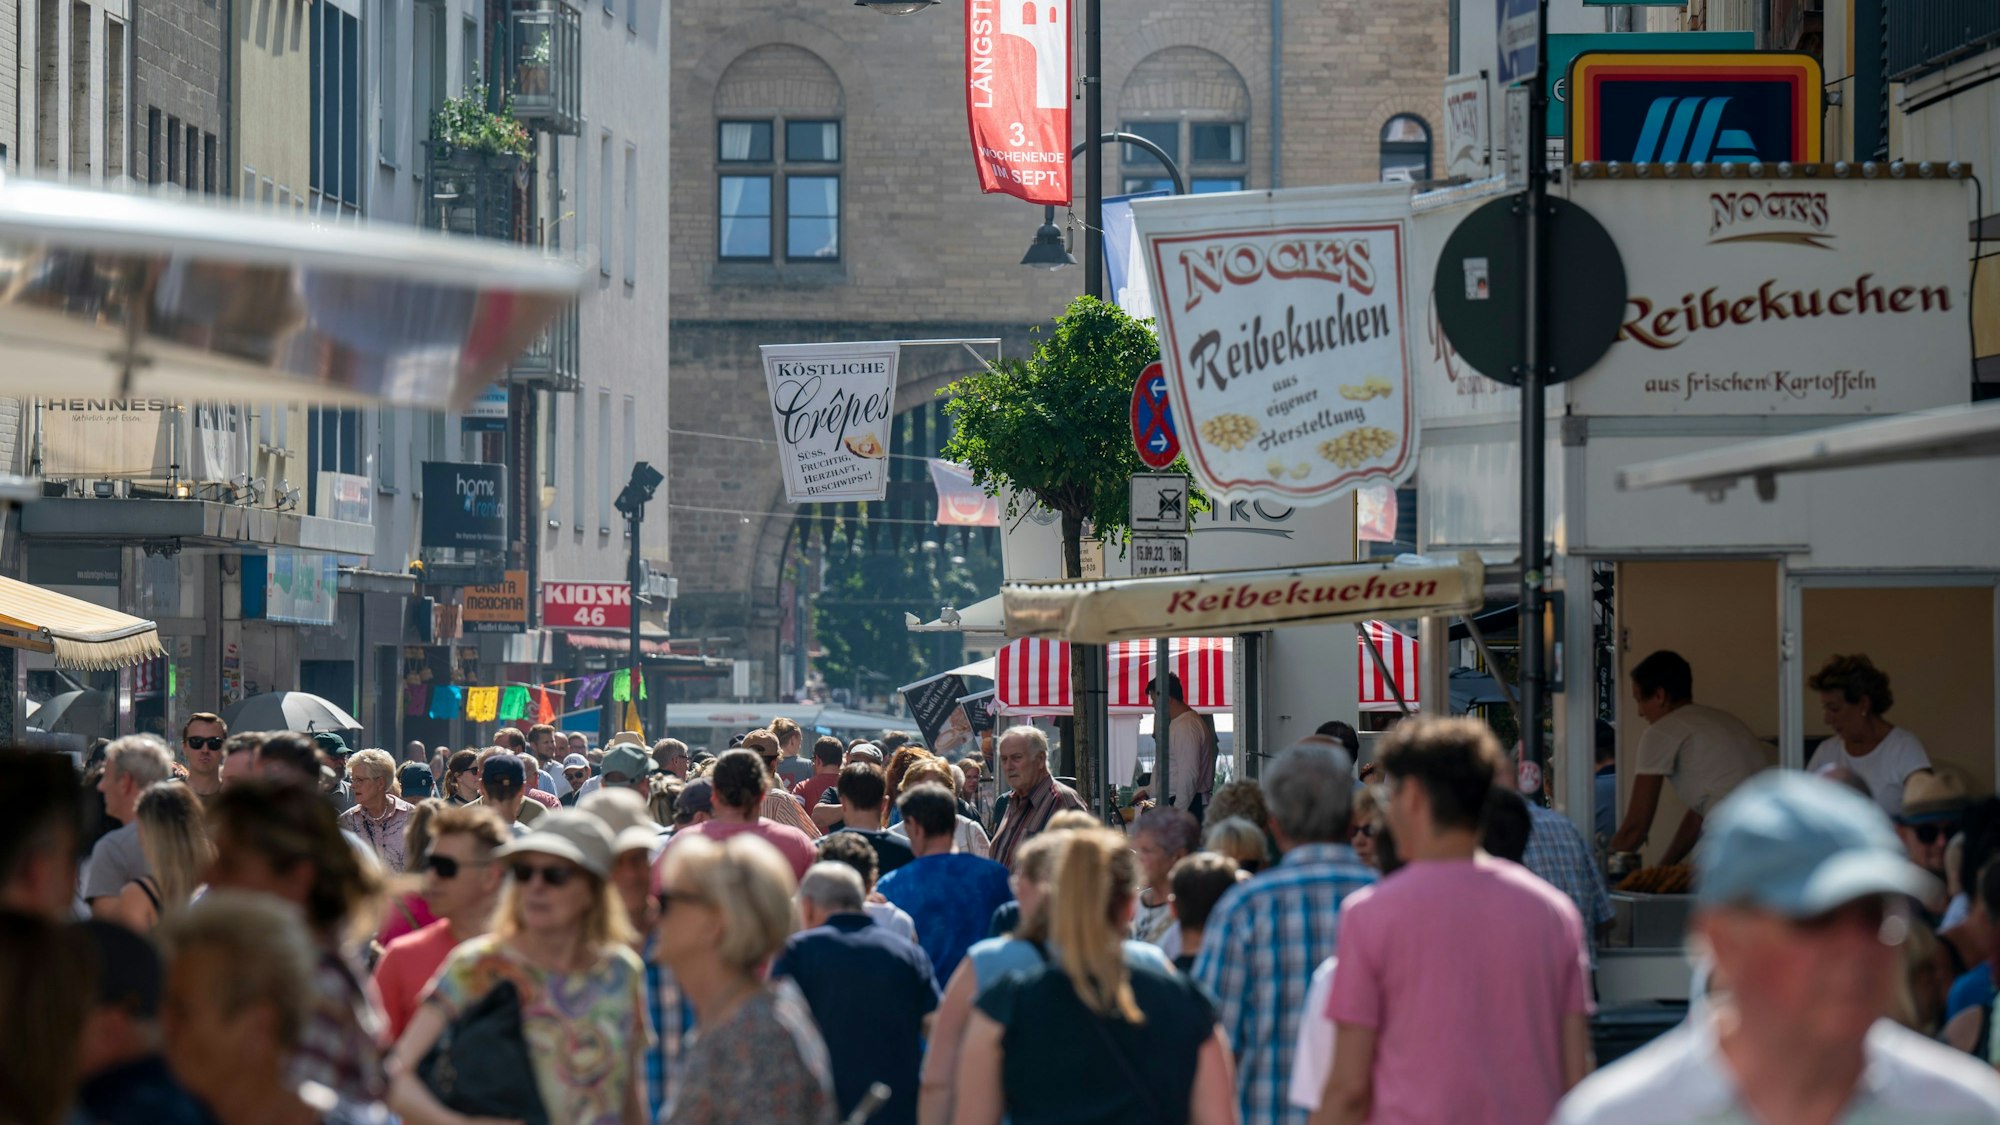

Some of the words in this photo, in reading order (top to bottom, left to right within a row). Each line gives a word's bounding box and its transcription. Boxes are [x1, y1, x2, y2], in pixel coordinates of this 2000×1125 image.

[970, 0, 993, 108] LÄNGST
[1009, 122, 1034, 147] 3.
[979, 147, 1065, 164] WOCHENENDE
[992, 163, 1009, 179] IM
[1011, 170, 1061, 187] SEPT.
[1709, 192, 1830, 235] NOCK'S
[1179, 239, 1376, 313] NOCK'S
[1614, 273, 1953, 350] Reibekuchen
[1188, 293, 1391, 392] Reibekuchen
[777, 362, 886, 377] KÖSTLICHE
[1272, 375, 1298, 393] aus
[1645, 379, 1680, 393] aus
[1685, 371, 1767, 401] frischen
[1770, 370, 1877, 399] Kartoffeln
[48, 398, 165, 411] HENNES
[774, 375, 890, 452] Crêpes
[1266, 388, 1319, 418] eigener
[1257, 406, 1367, 450] Herstellung
[797, 449, 827, 462] SÜSS,
[800, 455, 852, 473] FRUCHTIG,
[456, 473, 495, 497] home
[804, 464, 860, 484] HERZHAFT,
[806, 471, 873, 495] BESCHWIPST!
[467, 596, 524, 611] MEXICANA
[545, 584, 631, 605] KIOSK
[1166, 575, 1437, 614] Reibekuchen
[573, 607, 606, 626] 46
